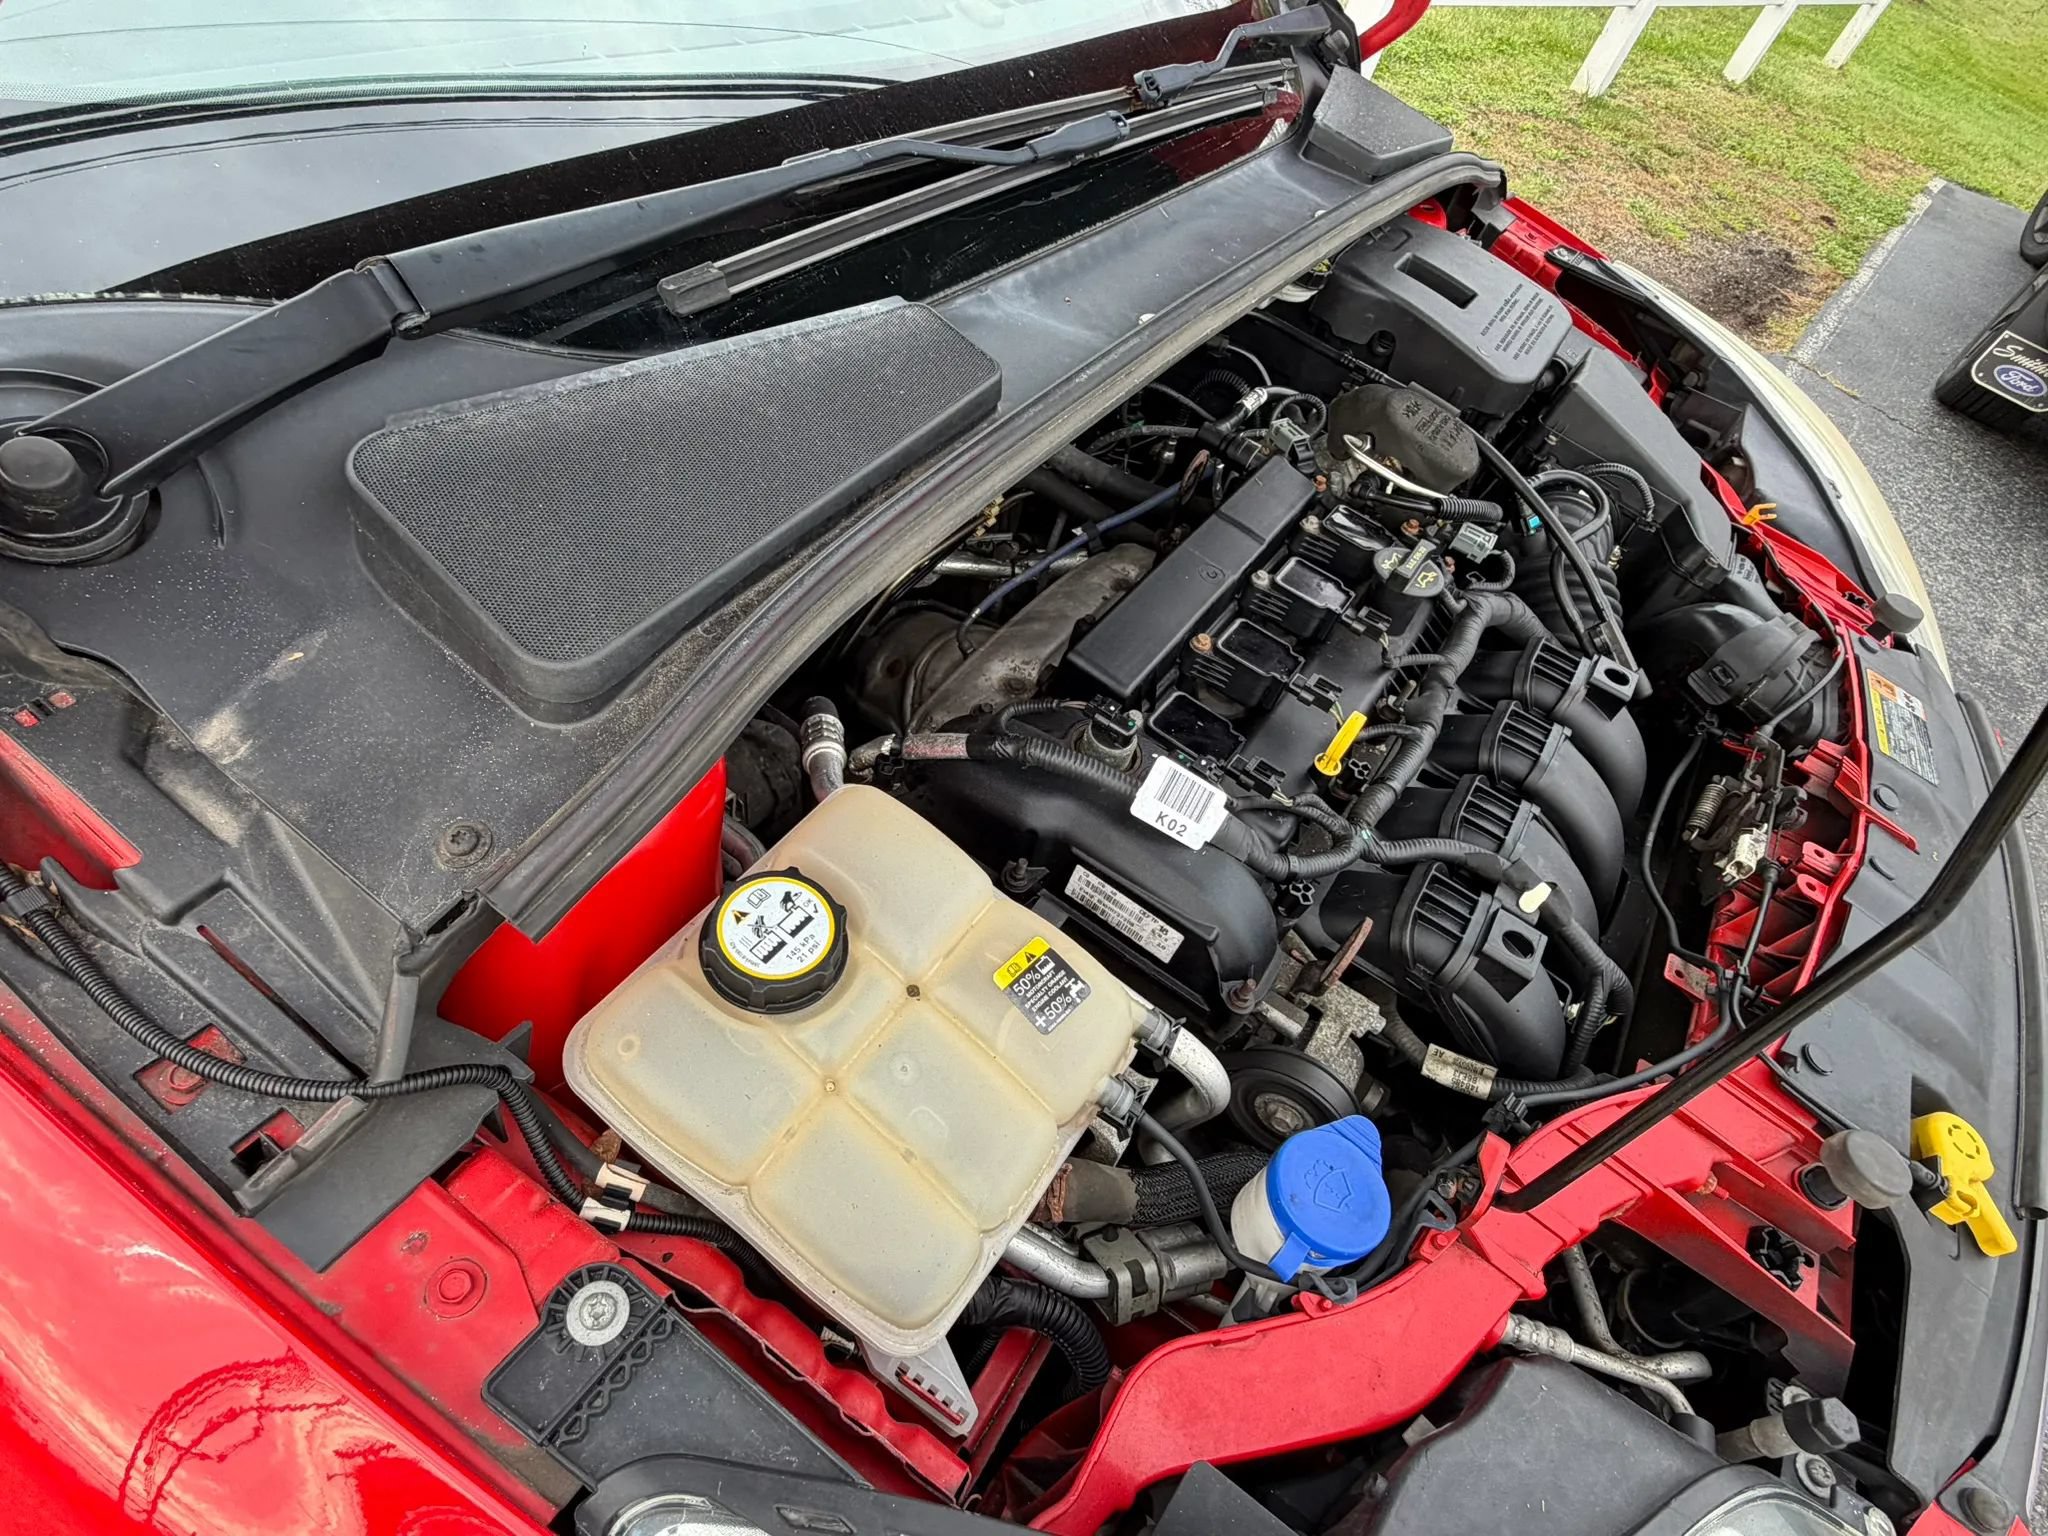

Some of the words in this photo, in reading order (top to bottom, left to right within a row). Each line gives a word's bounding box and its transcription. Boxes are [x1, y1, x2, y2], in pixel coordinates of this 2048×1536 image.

[2000, 371, 2040, 392] Ford
[1155, 811, 1187, 837] K02
[786, 946, 801, 960] 145
[800, 933, 816, 947] kPa
[797, 952, 808, 963] 21
[1012, 970, 1041, 996] 50%
[1025, 986, 1048, 1009] SPECIALTY
[1047, 969, 1066, 988] ORANGE
[1026, 970, 1056, 998] MOTORCRAFT
[1031, 994, 1049, 1012] ENGINE
[1048, 976, 1069, 996] COOLANT
[1432, 1049, 1445, 1058] AE
